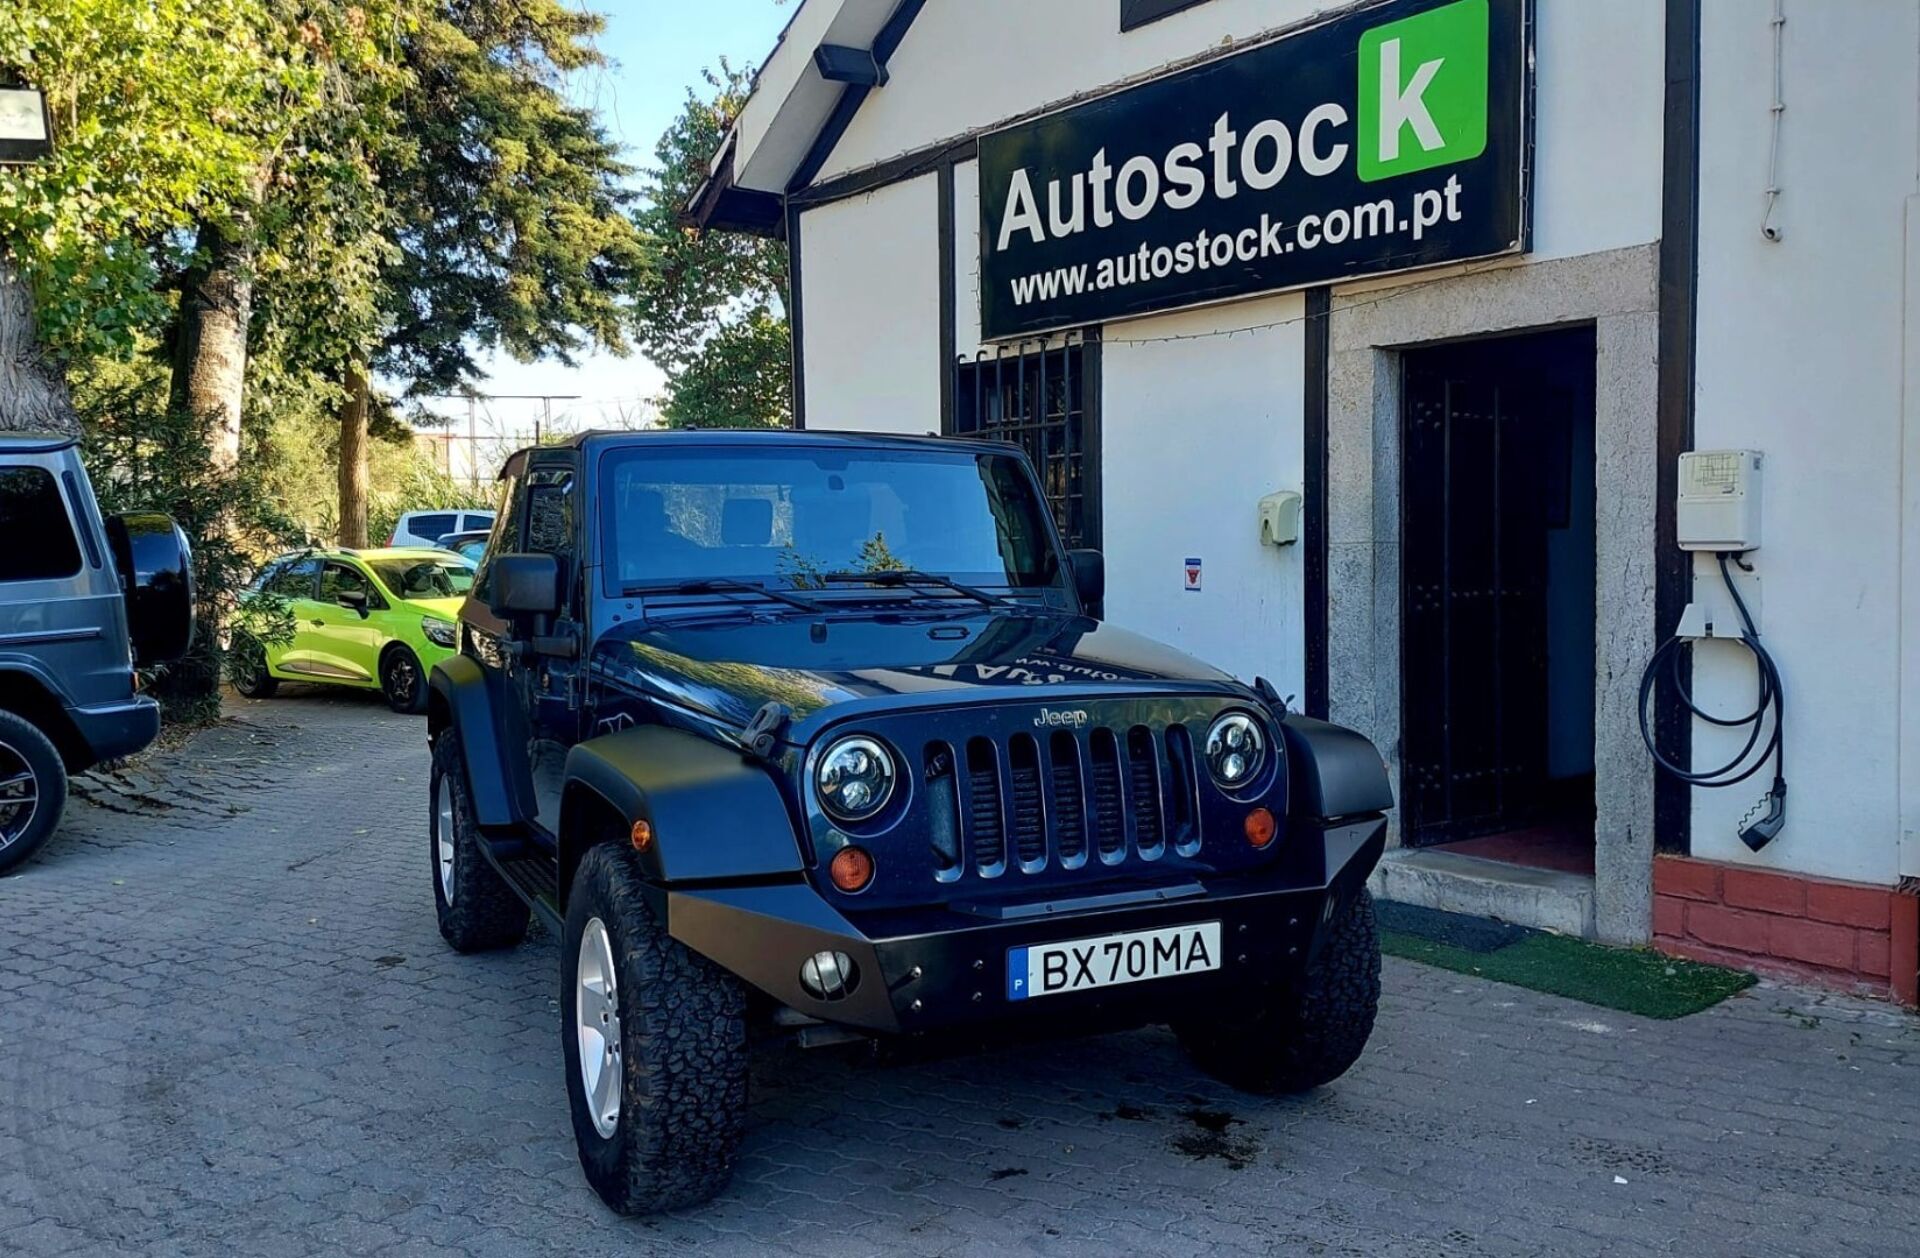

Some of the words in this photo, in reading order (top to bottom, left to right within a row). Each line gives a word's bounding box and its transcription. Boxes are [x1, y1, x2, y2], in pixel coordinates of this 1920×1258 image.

[997, 37, 1446, 252] Autostock
[1010, 173, 1463, 306] www.autostock.com.pt
[1033, 707, 1088, 729] Jeep
[1014, 979, 1024, 991] P
